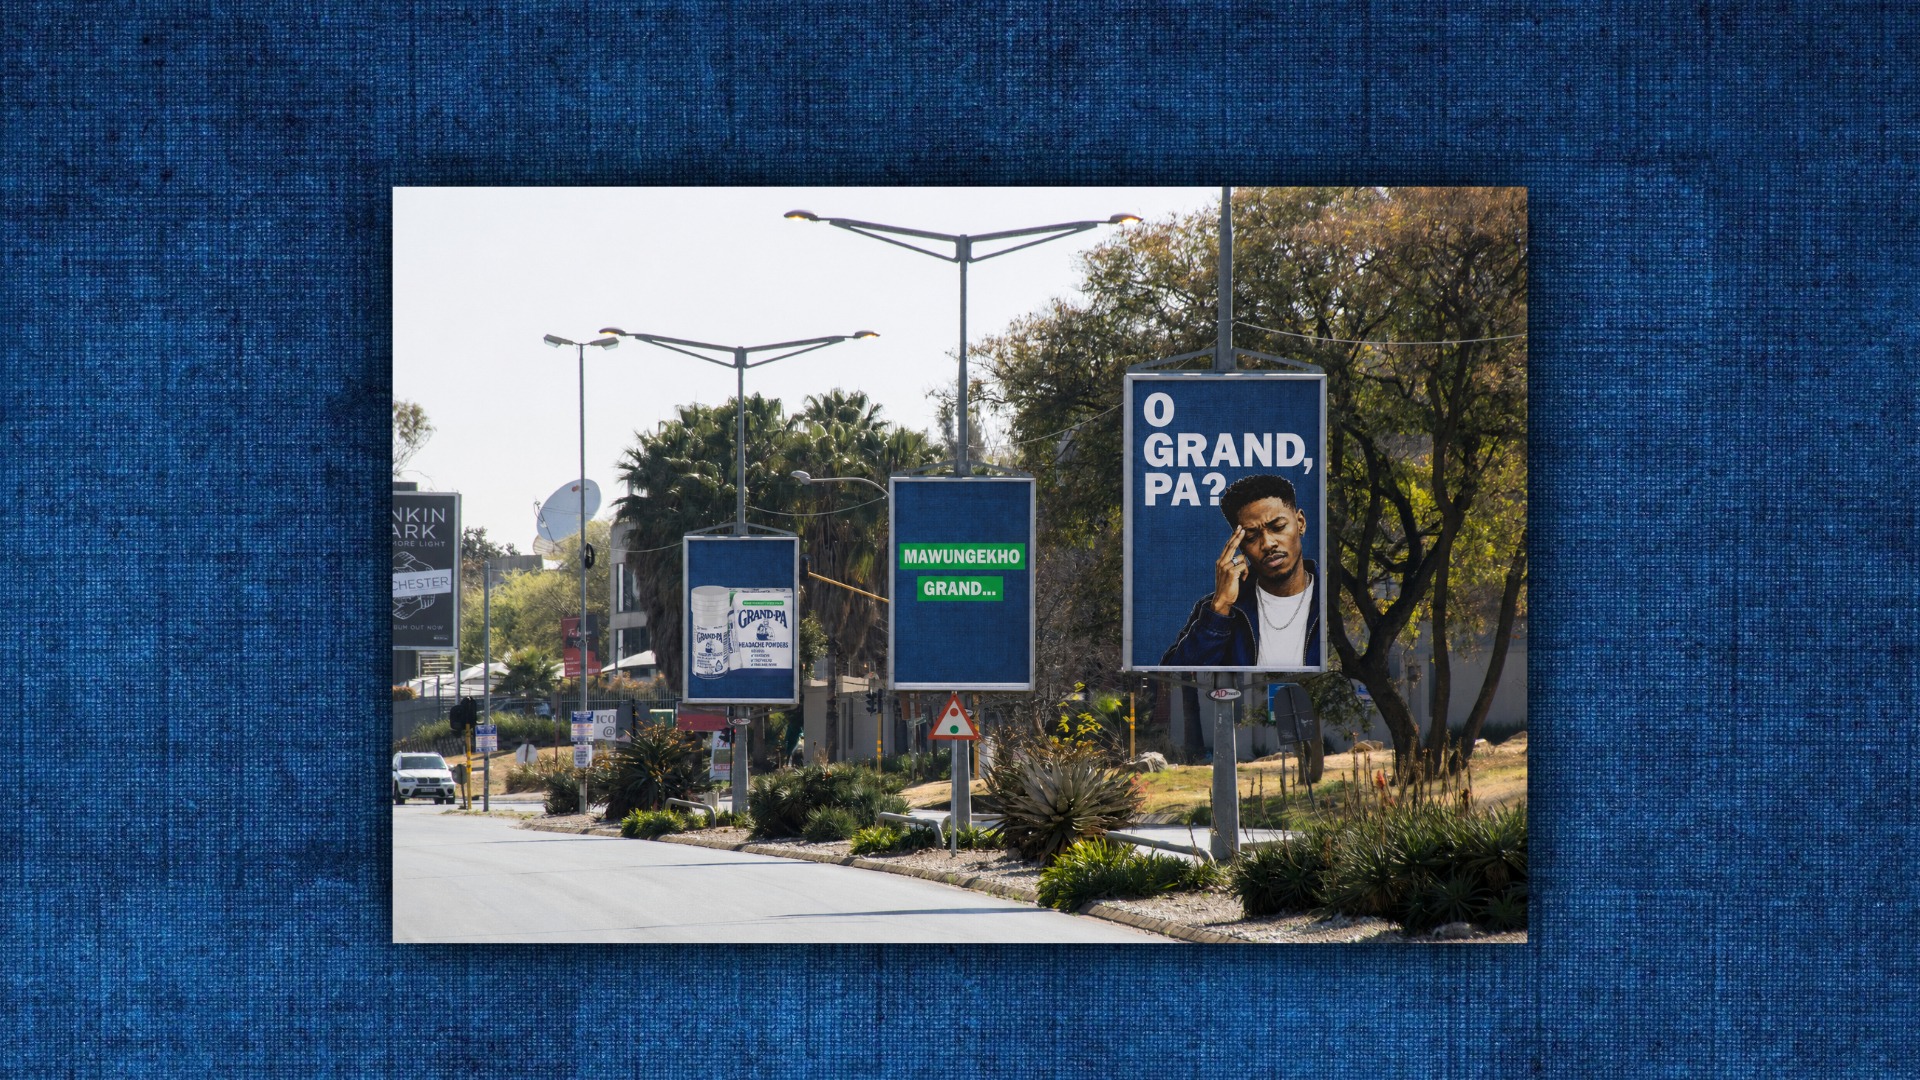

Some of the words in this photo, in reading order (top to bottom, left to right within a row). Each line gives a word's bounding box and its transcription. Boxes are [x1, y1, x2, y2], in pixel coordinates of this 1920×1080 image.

[1143, 392, 1175, 427] O
[1143, 432, 1313, 475] GRAND,
[1144, 472, 1227, 506] PA?
[904, 549, 1021, 564] MAWUNGEKHO
[393, 577, 448, 591] CHESTER
[923, 581, 997, 596] GRAND...
[738, 609, 788, 628] GRAND-PA
